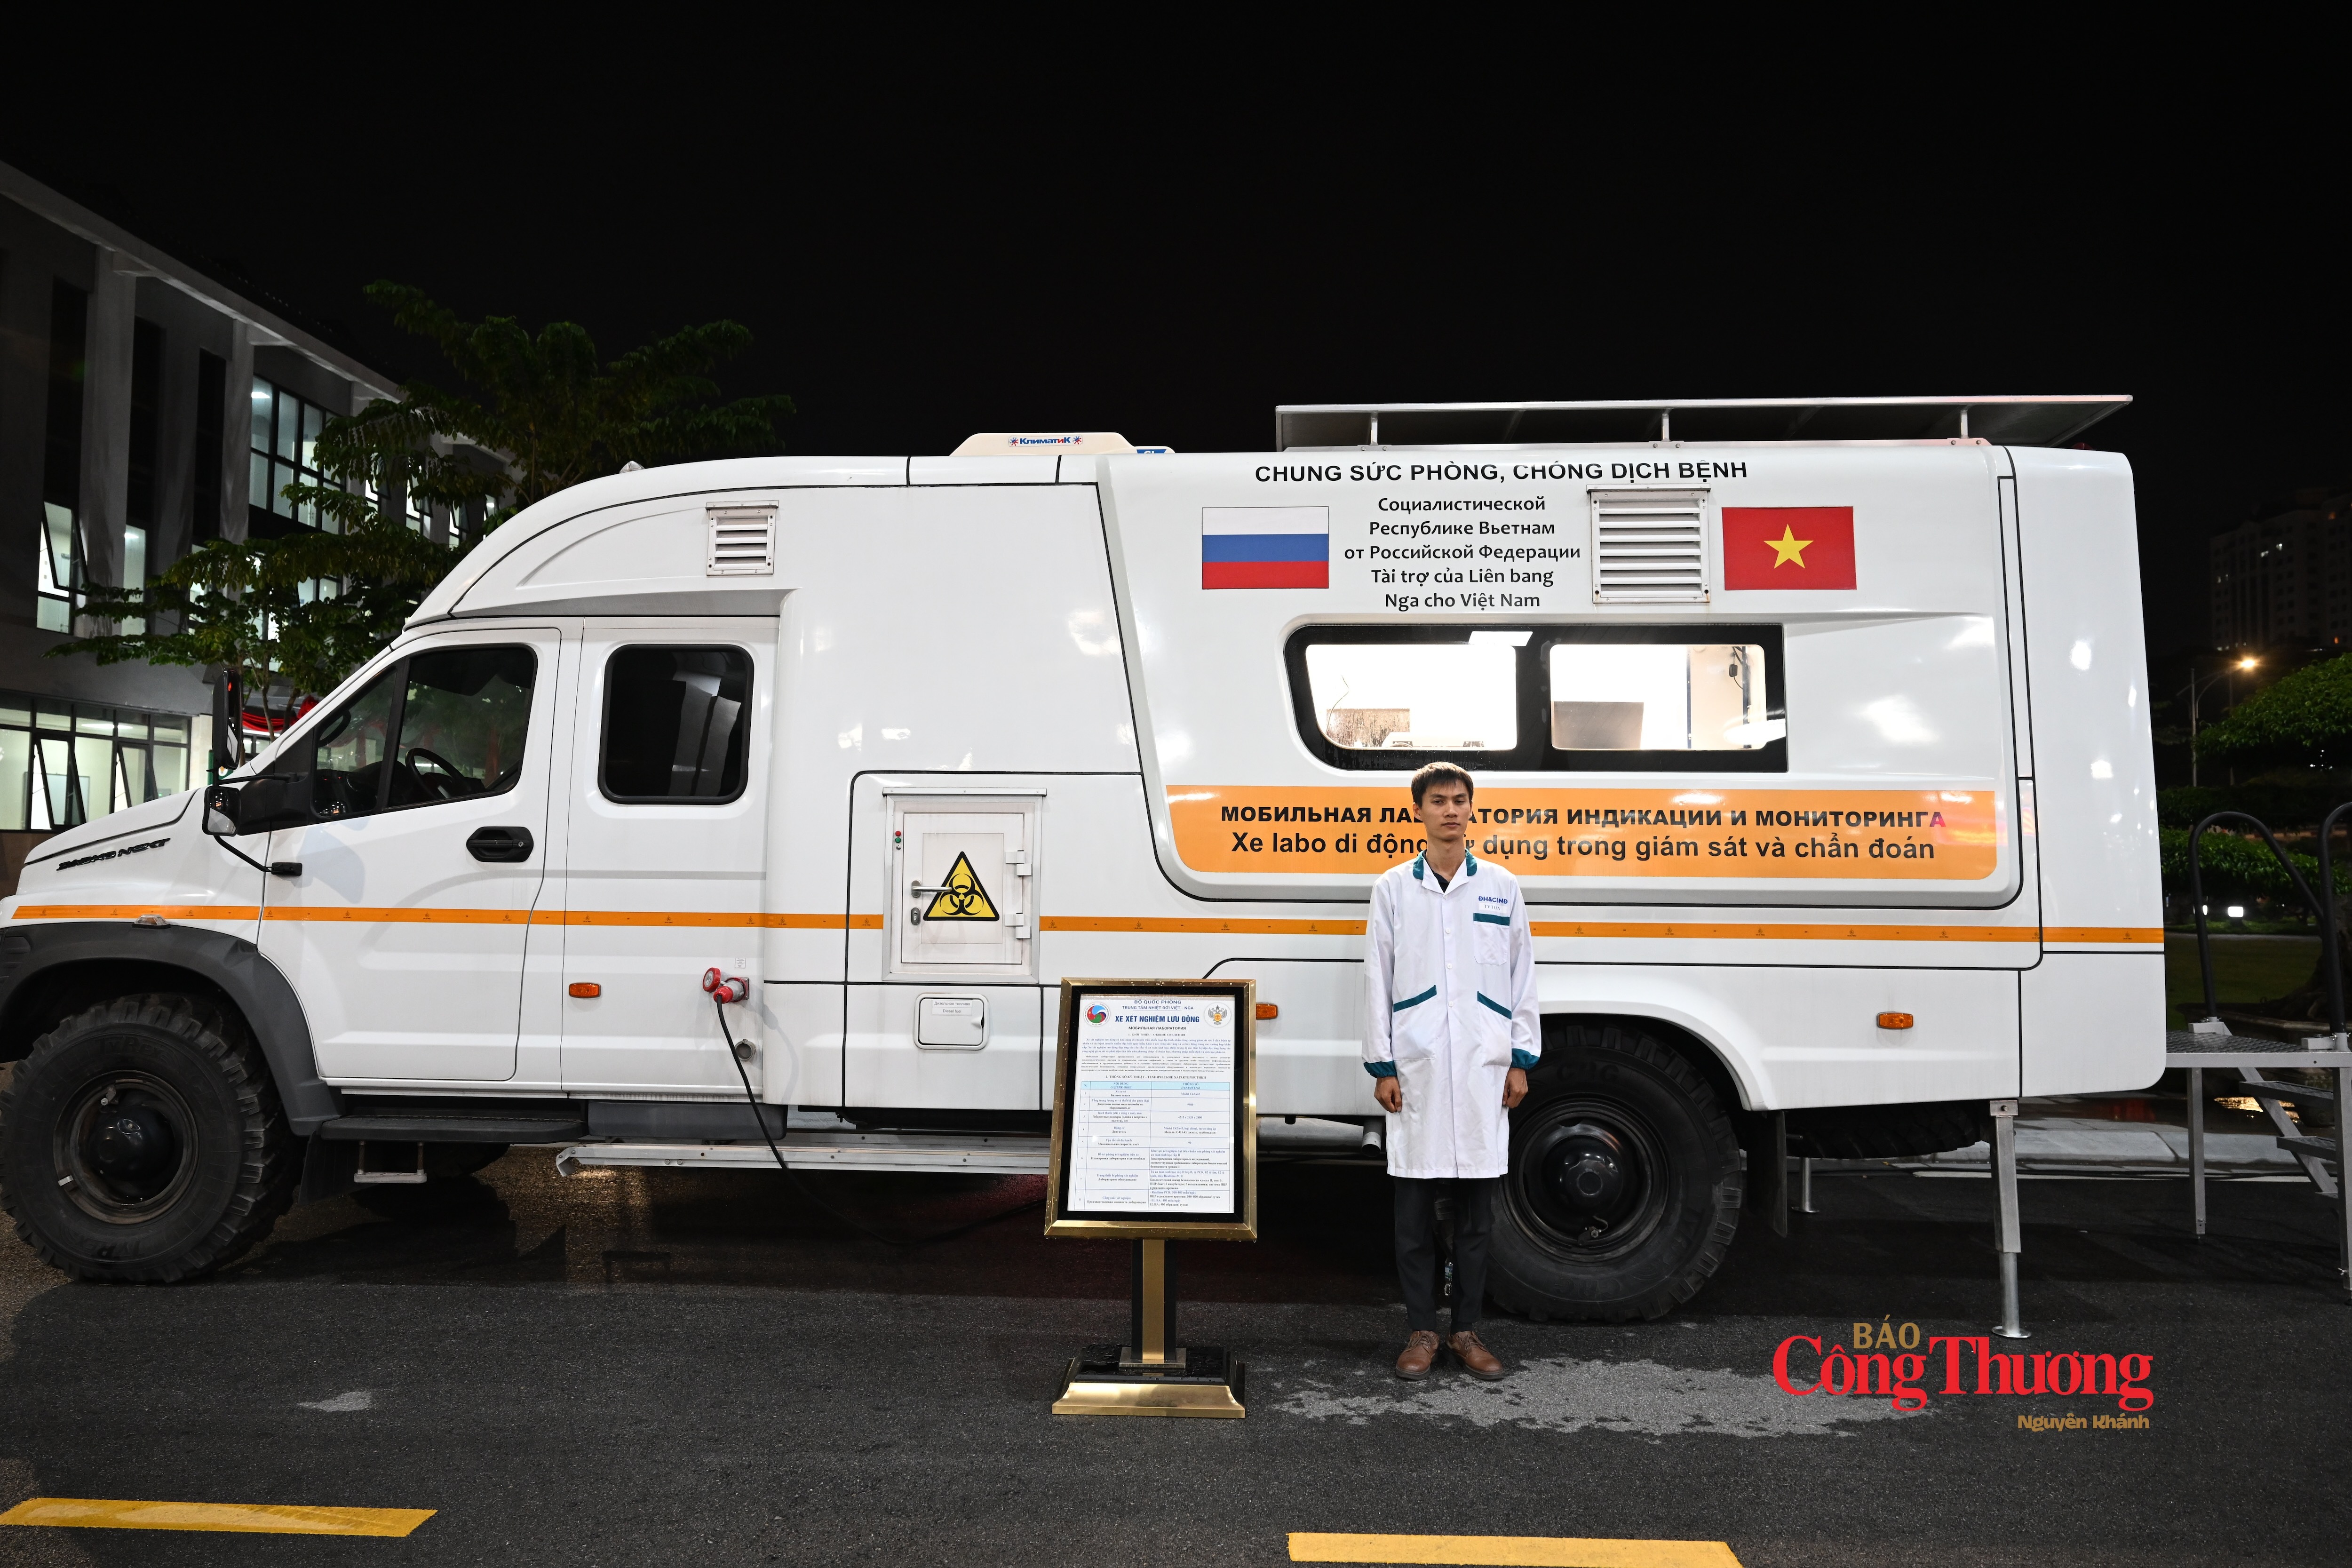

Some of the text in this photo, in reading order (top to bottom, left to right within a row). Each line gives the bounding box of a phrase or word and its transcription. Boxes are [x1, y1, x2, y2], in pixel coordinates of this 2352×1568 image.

[1255, 465, 1342, 482] CHUNG
[1350, 462, 1402, 481] SỨC
[1411, 461, 1505, 483] PHÒNG,
[1612, 462, 1669, 483] DỊCH
[1678, 460, 1747, 482] BỆNH
[1379, 496, 1545, 514] Социалистической
[1370, 521, 1554, 538] Республике Вьетнам
[1345, 545, 1580, 562] от Российской Федерации
[1371, 567, 1553, 587] Tài trợ của Liên bang
[1386, 593, 1540, 612] Nga cho Việt Nam
[1221, 806, 1946, 828] МОБИЛЬНАЯ ЛАТОРИЯ ИНДИКАЦИИ И МОНИТОРИНГА
[1232, 832, 1263, 852] Xe
[1273, 833, 1326, 852] labo
[1335, 834, 1357, 852] di
[1483, 835, 1547, 860] dụng
[1557, 836, 1625, 861] trong
[1636, 836, 1698, 861] giám
[1708, 836, 1748, 857] sát
[1756, 836, 1785, 857] và
[1795, 833, 1858, 858] chẩn
[1869, 836, 1934, 859] đoán
[1139, 1015, 1165, 1023] NGHIỆM
[1182, 1015, 1200, 1023] ĐỘNG
